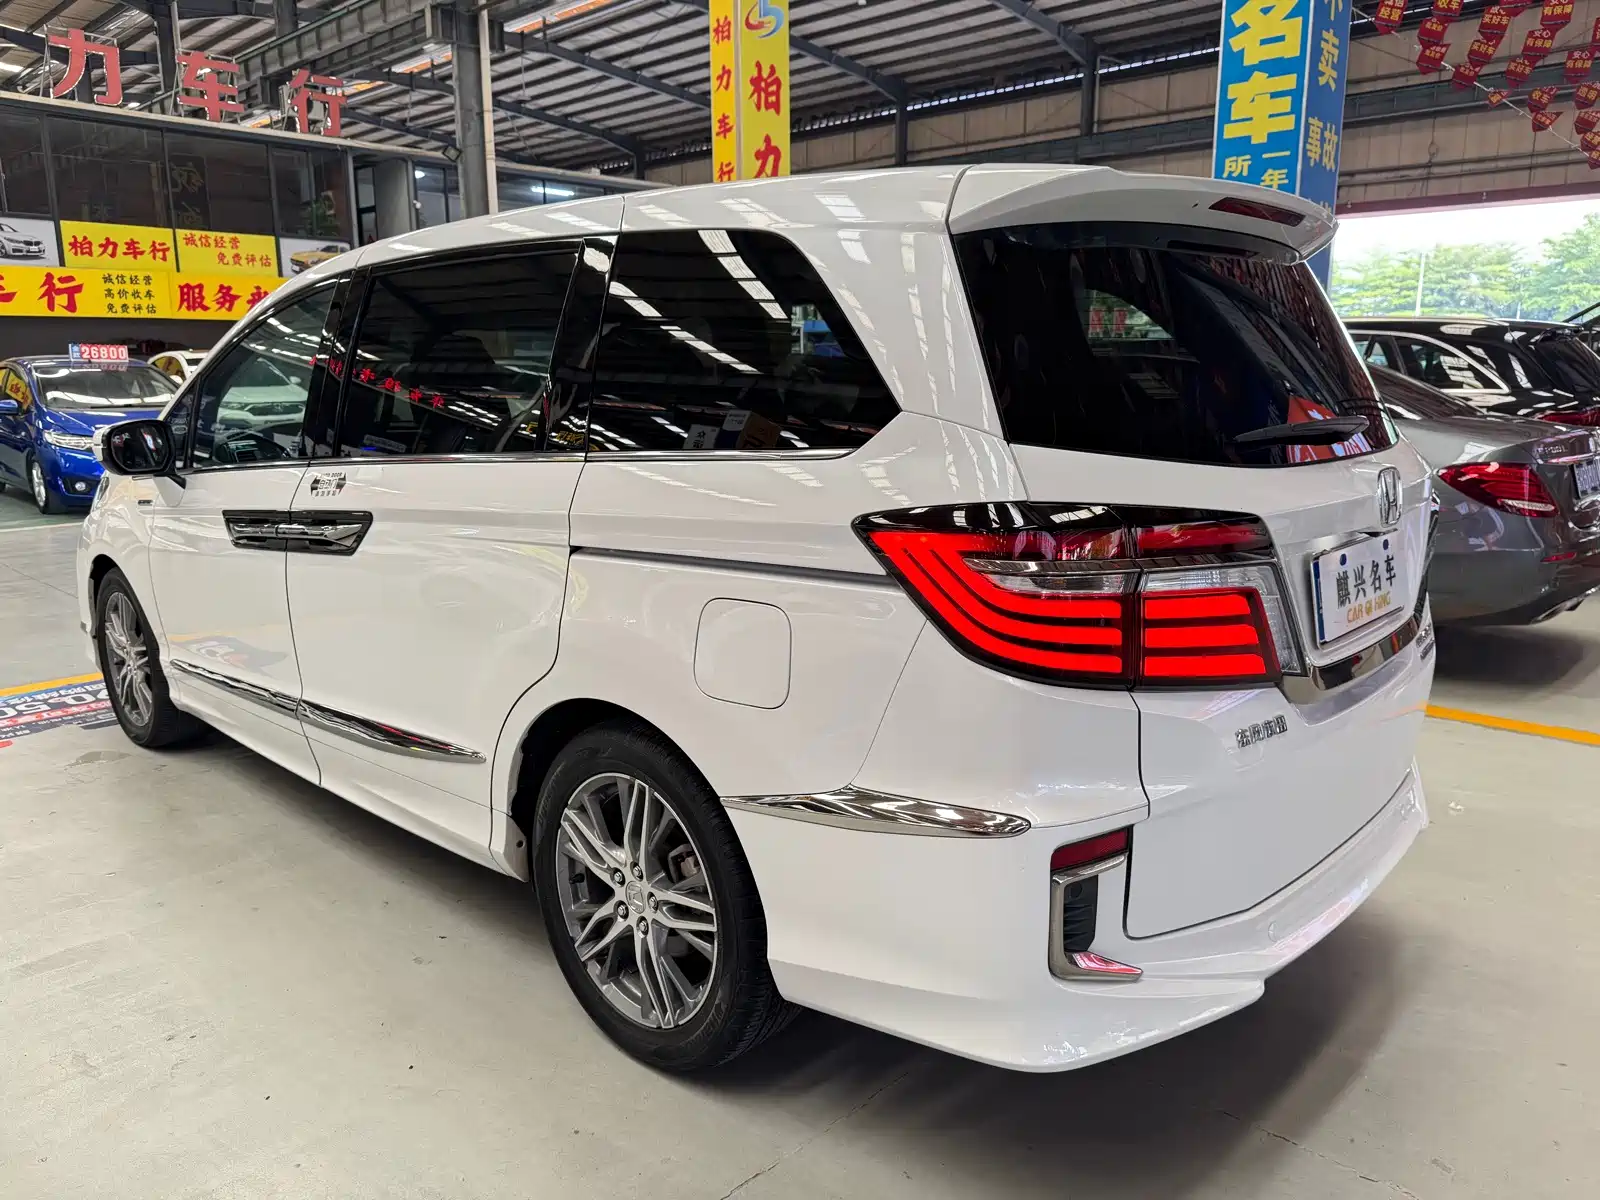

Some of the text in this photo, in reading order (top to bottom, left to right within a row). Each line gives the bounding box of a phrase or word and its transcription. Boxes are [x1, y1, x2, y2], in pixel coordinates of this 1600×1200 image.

[1223, 0, 1303, 145] 名车
[50, 28, 347, 137] 力车行
[713, 15, 735, 182] 柏力车行
[748, 60, 782, 178] 柏力
[68, 235, 170, 263] 柏力车行
[183, 232, 241, 250] 诚信经营
[217, 252, 273, 268] 免费评估
[102, 273, 153, 285] 诚信经营
[104, 288, 155, 301] 高价收车
[106, 303, 157, 315] 免费评估
[81, 346, 126, 359] 26800
